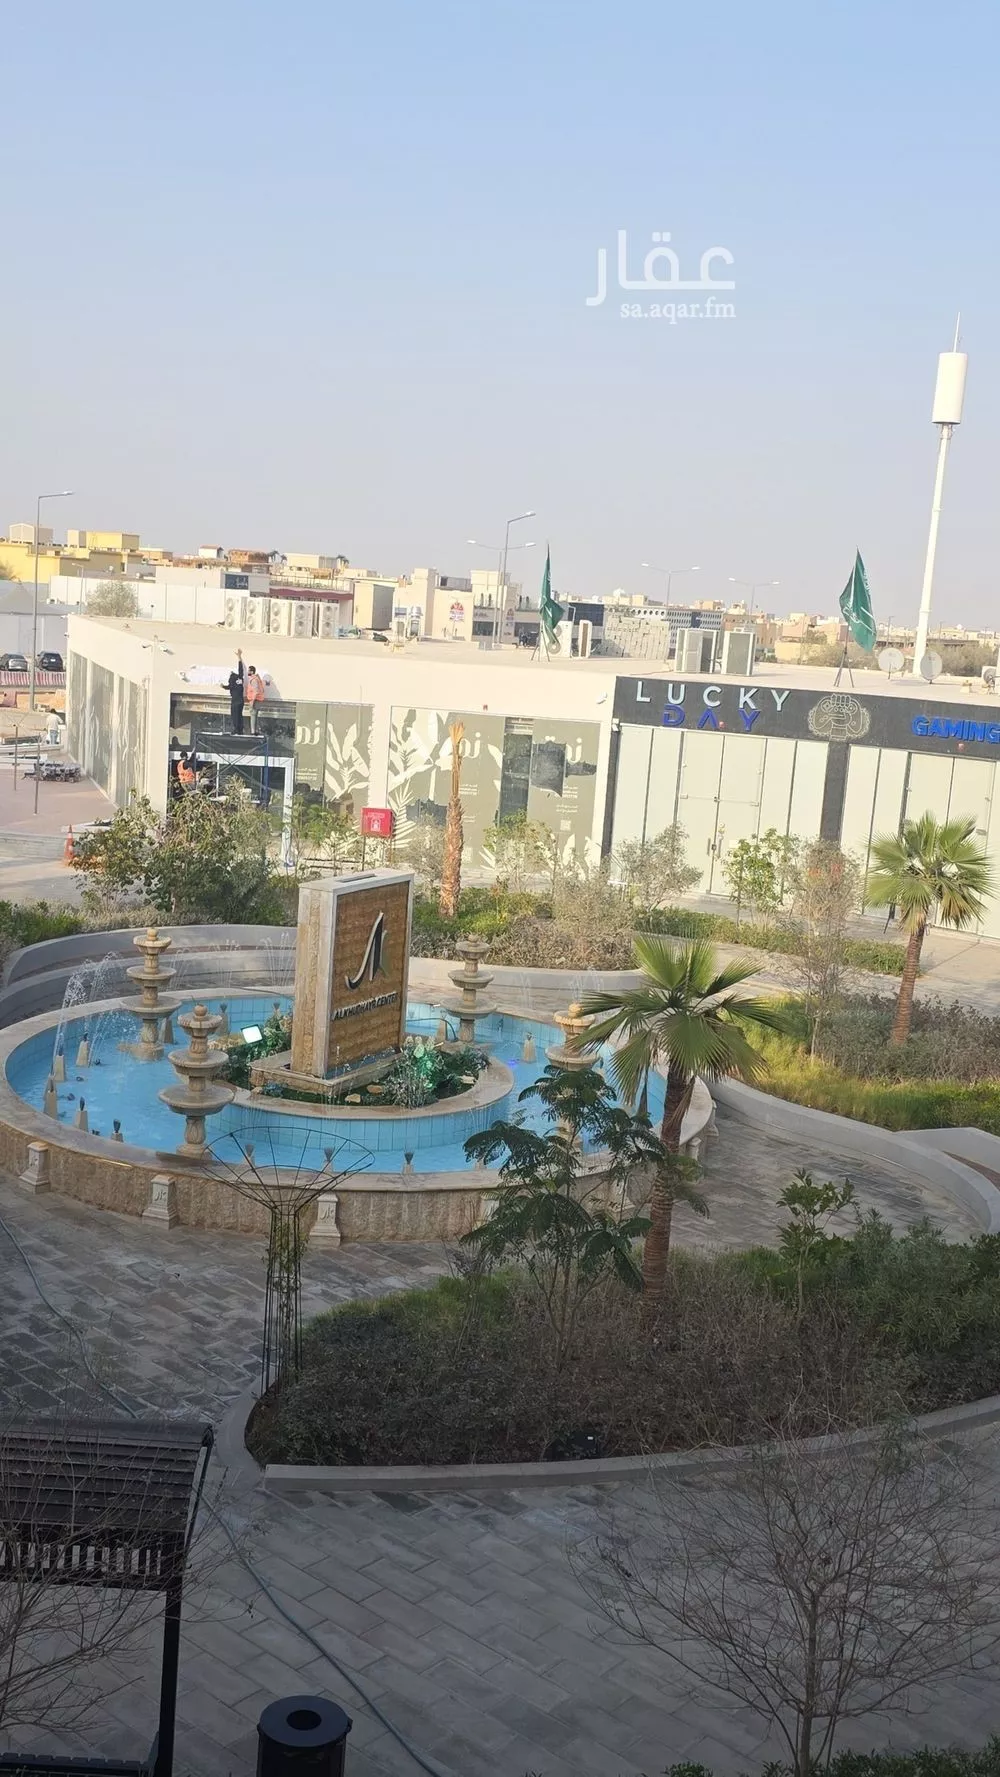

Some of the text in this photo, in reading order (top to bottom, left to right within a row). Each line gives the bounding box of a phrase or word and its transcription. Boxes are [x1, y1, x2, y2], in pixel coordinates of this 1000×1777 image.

[635, 680, 791, 712] LUCKY
[661, 703, 762, 732] DAY
[911, 714, 1000, 744] GAMING
